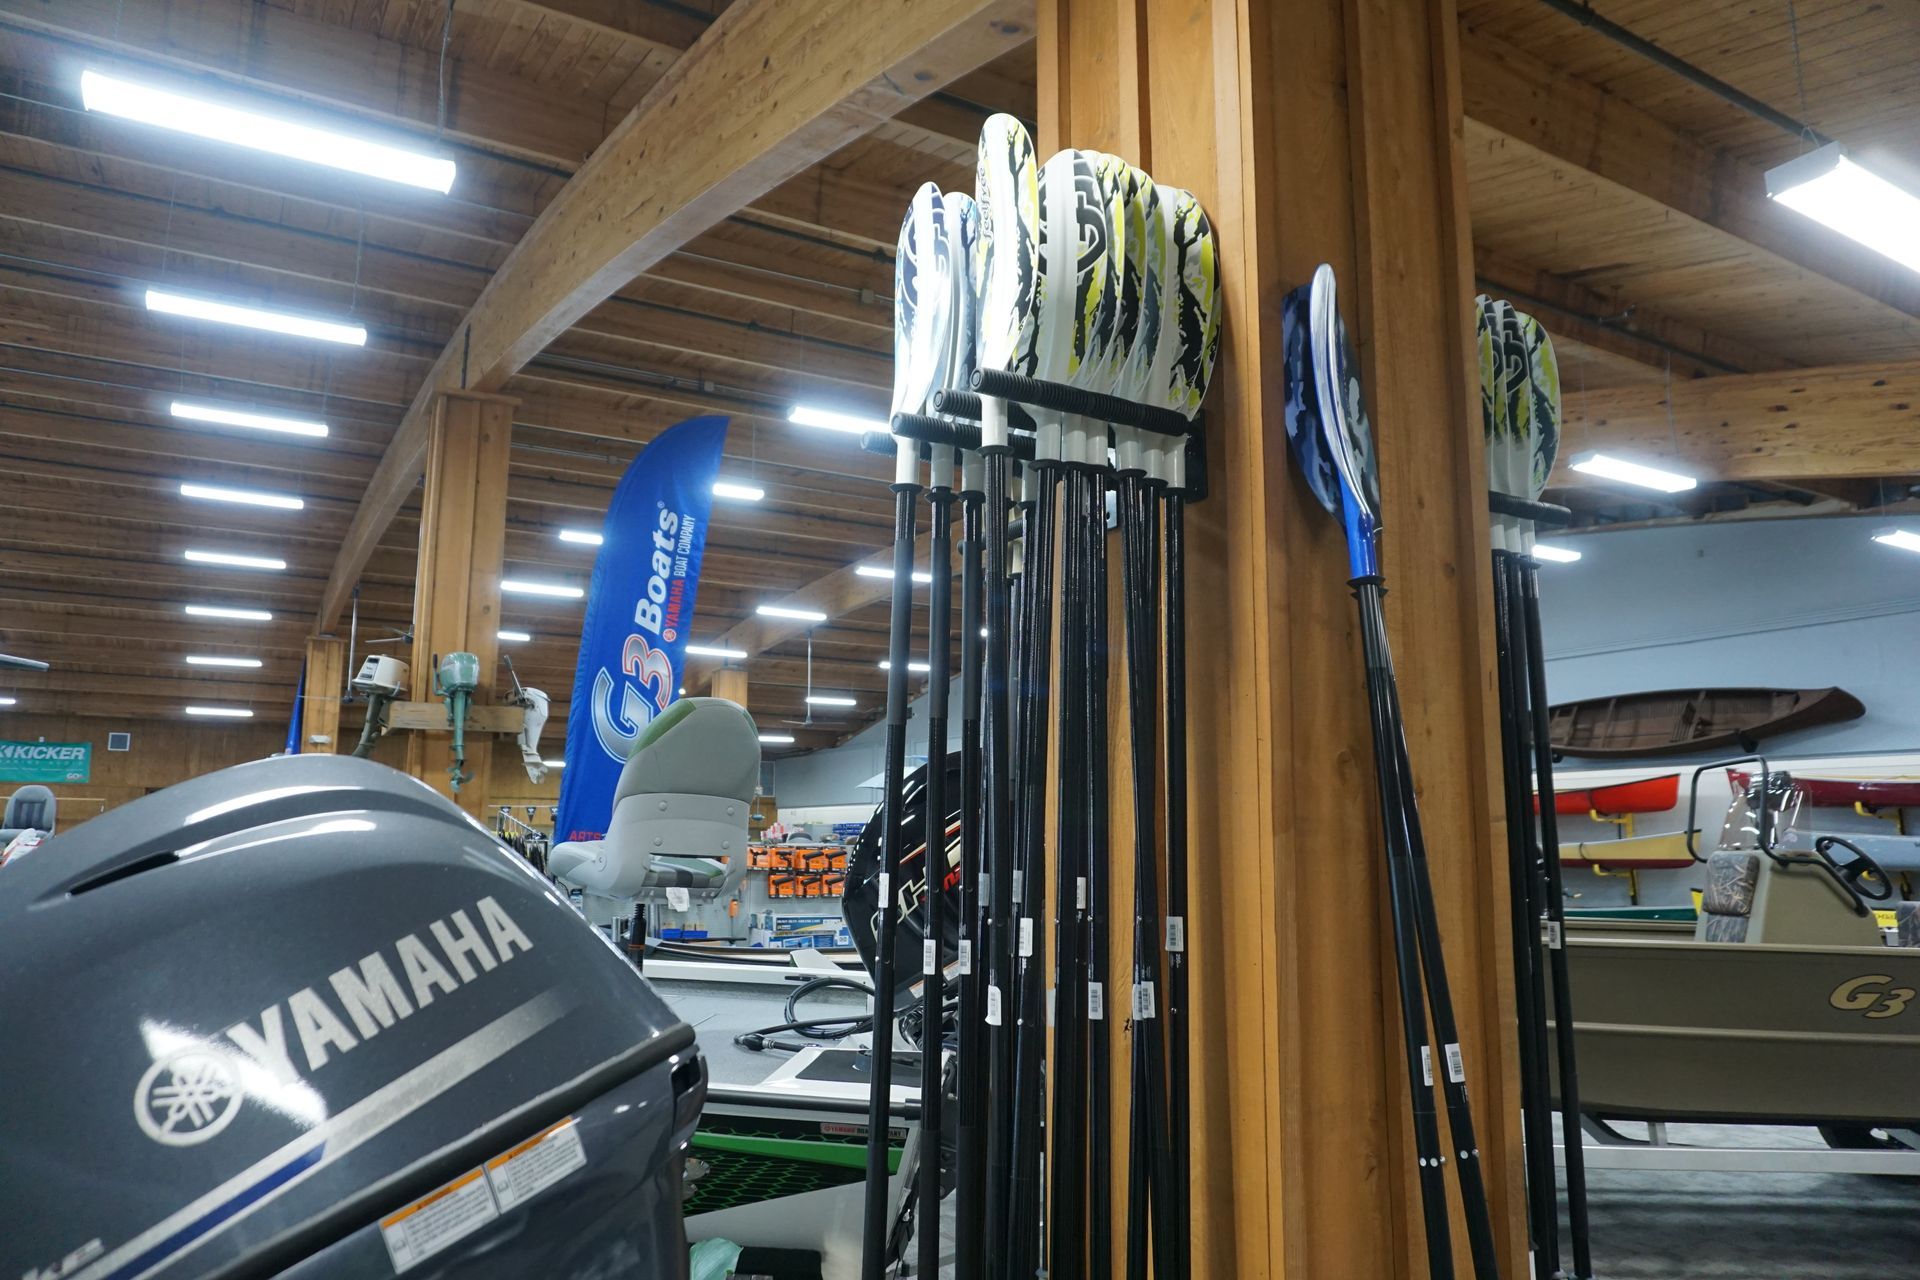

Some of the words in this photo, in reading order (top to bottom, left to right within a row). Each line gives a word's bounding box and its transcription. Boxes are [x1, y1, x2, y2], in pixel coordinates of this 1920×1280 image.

[677, 514, 696, 555] COMPANY
[673, 555, 689, 578] BOAT
[664, 579, 685, 627] YAMAHA
[591, 633, 673, 764] G3
[225, 895, 535, 1087] YAMAHA
[1829, 974, 1917, 1019] G3
